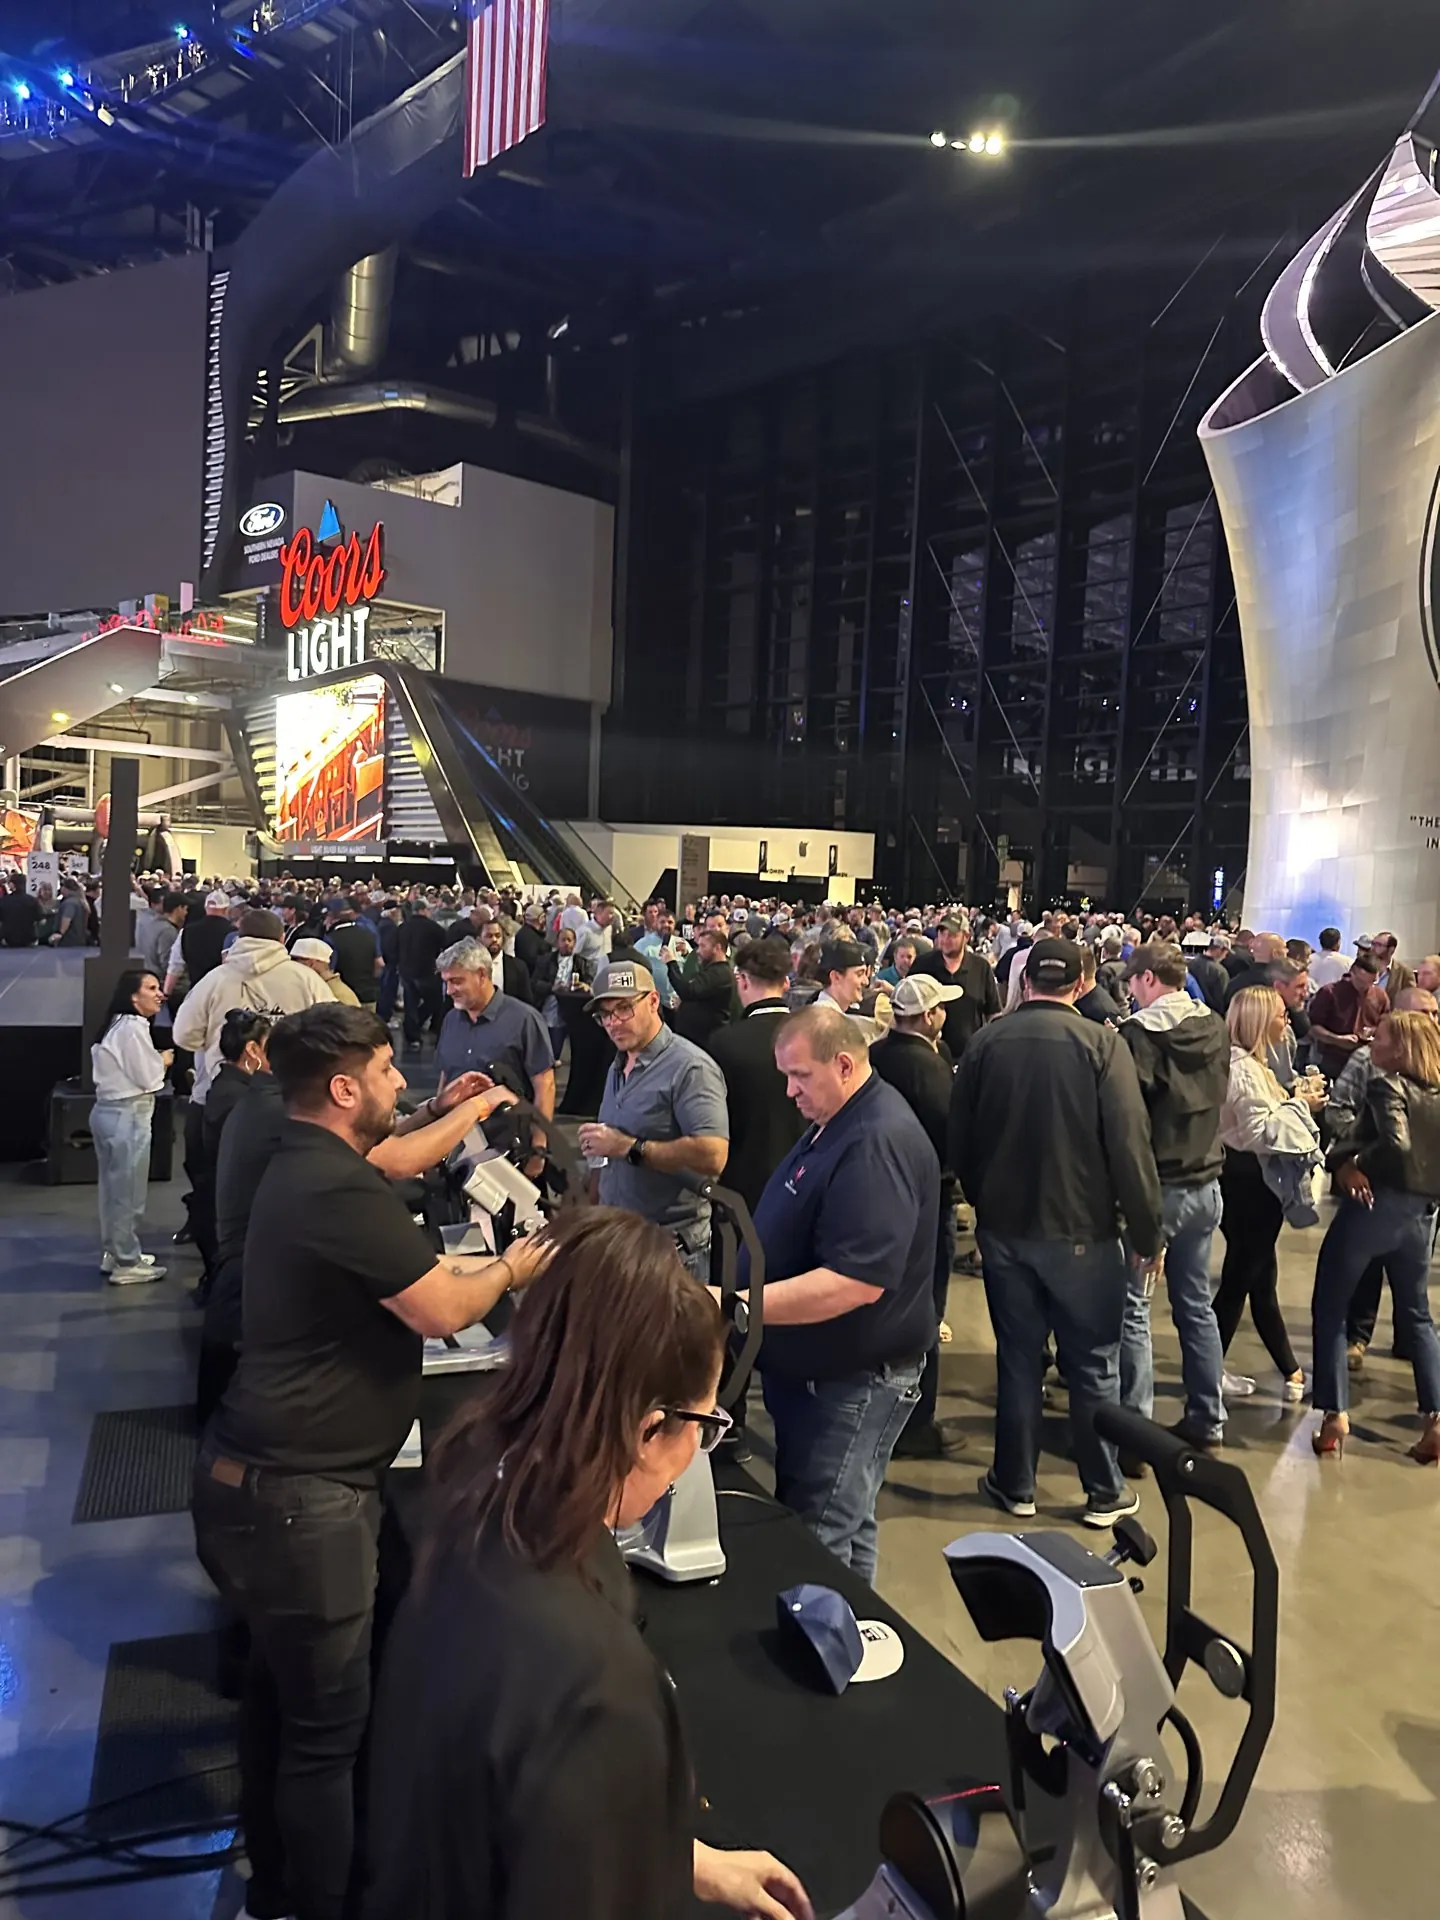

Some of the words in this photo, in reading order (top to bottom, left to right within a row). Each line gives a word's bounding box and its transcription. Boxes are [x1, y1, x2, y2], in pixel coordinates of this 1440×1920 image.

[280, 521, 384, 628] Coors
[288, 606, 370, 682] LIGHT
[31, 861, 51, 870] 248
